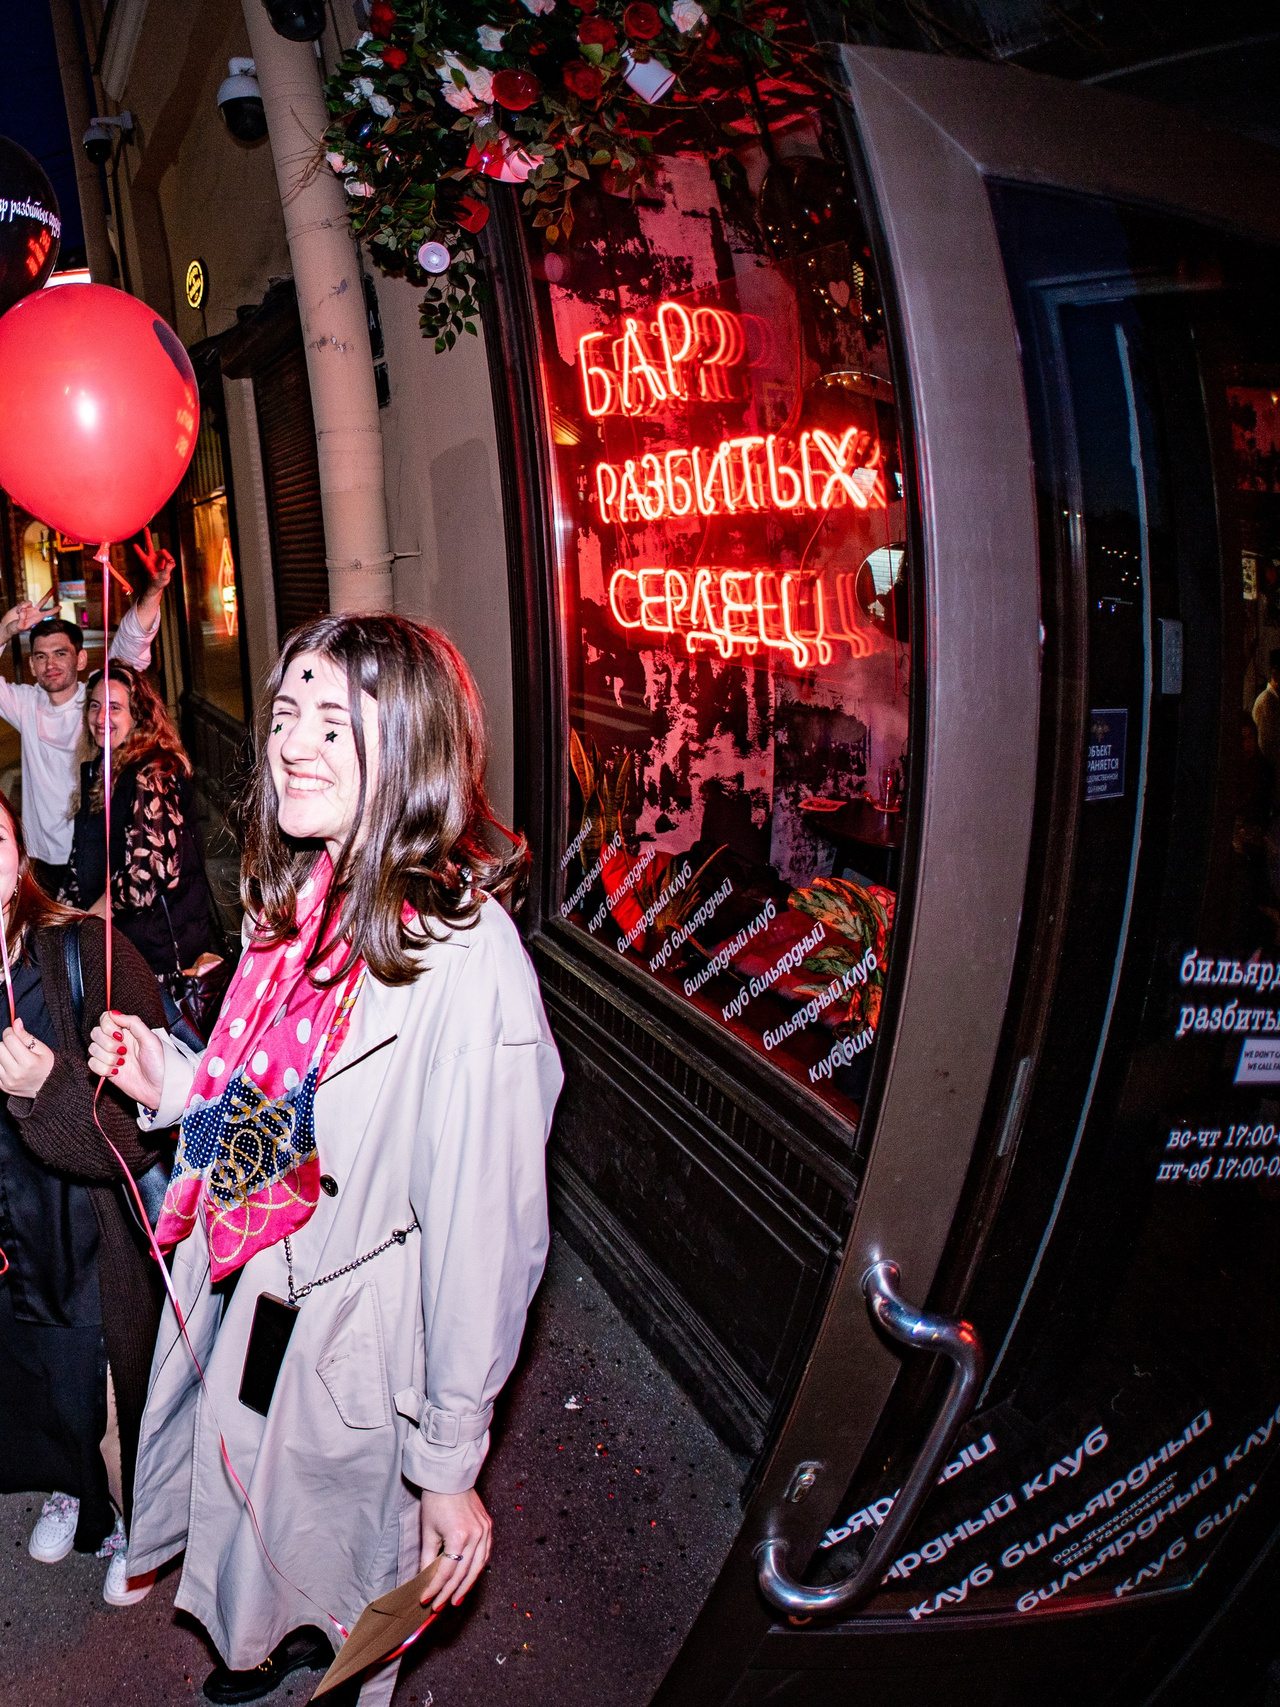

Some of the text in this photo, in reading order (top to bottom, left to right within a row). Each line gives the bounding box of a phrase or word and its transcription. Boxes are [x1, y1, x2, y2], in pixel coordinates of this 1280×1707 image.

[9, 195, 49, 225] разбитых
[577, 300, 694, 417] БАР
[595, 426, 869, 525] РАЗБИТЫХ
[609, 567, 811, 670] СЕРДЕЦ
[560, 830, 622, 918] бильярдный клуб
[587, 845, 657, 934] клуб бильярдный
[617, 860, 692, 954] бильярдный клуб
[649, 877, 734, 973] клуб бильярдный
[683, 898, 777, 997] бильярдный клуб
[721, 921, 826, 1022] клуб бильярдный
[762, 947, 878, 1051] бильярдный клуб
[808, 1043, 841, 1083] клуб
[1213, 1156, 1280, 1179] 17:00-0
[1223, 1125, 1280, 1148] 17:00-
[1016, 1404, 1280, 1613] бильярдный клу
[1022, 1425, 1109, 1500] клуб
[908, 1408, 1213, 1621] клуб бильярдный
[1115, 1536, 1188, 1597] клуб
